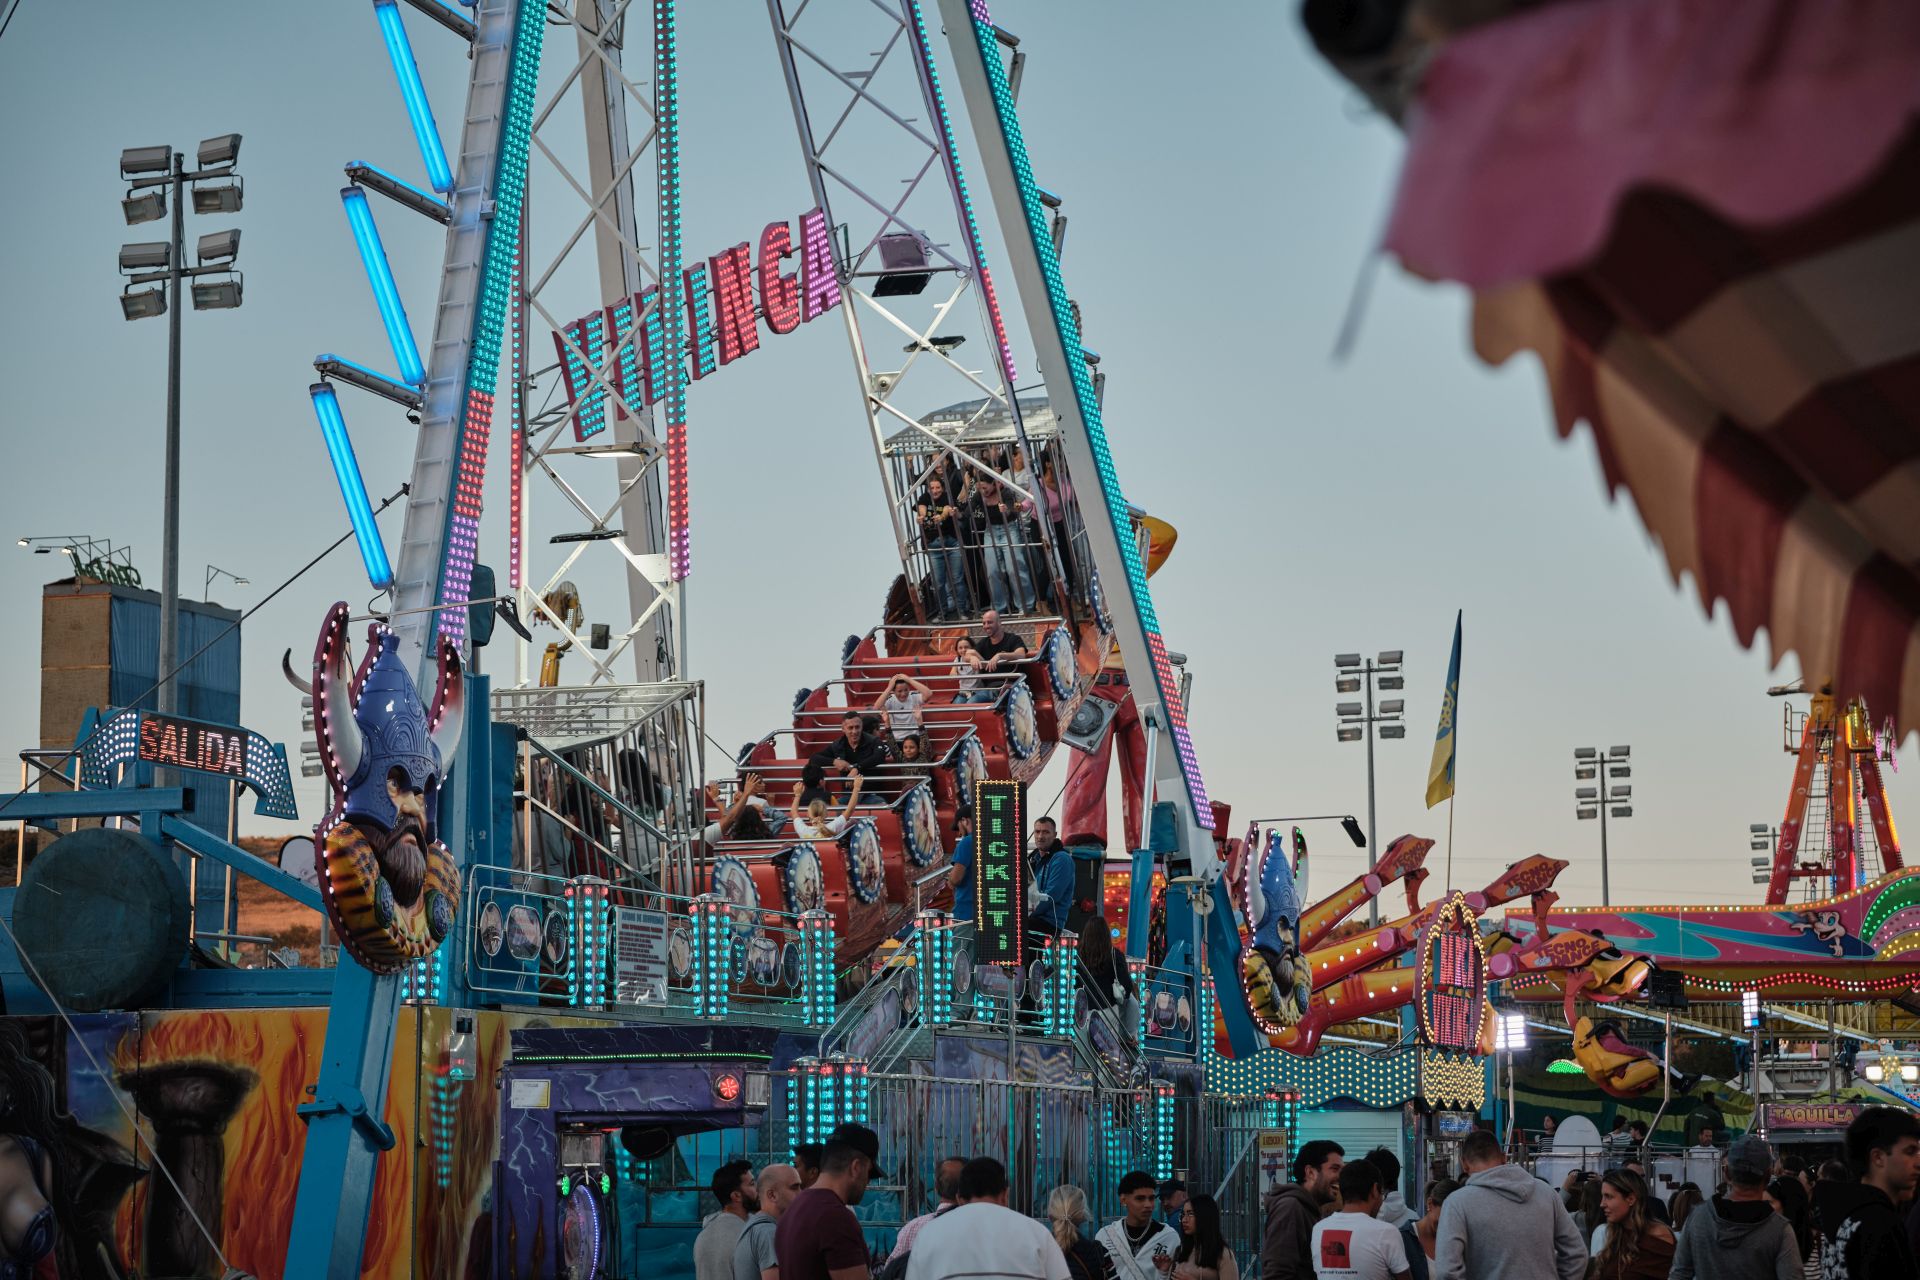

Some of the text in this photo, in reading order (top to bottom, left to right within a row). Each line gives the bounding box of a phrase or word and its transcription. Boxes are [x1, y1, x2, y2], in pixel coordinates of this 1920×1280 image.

[140, 720, 243, 776] SALIDA
[1504, 862, 1549, 888] TECNO
[1534, 938, 1586, 957] TECNO
[1551, 940, 1600, 966] DANCE
[1773, 1107, 1855, 1123] TAQUILLA
